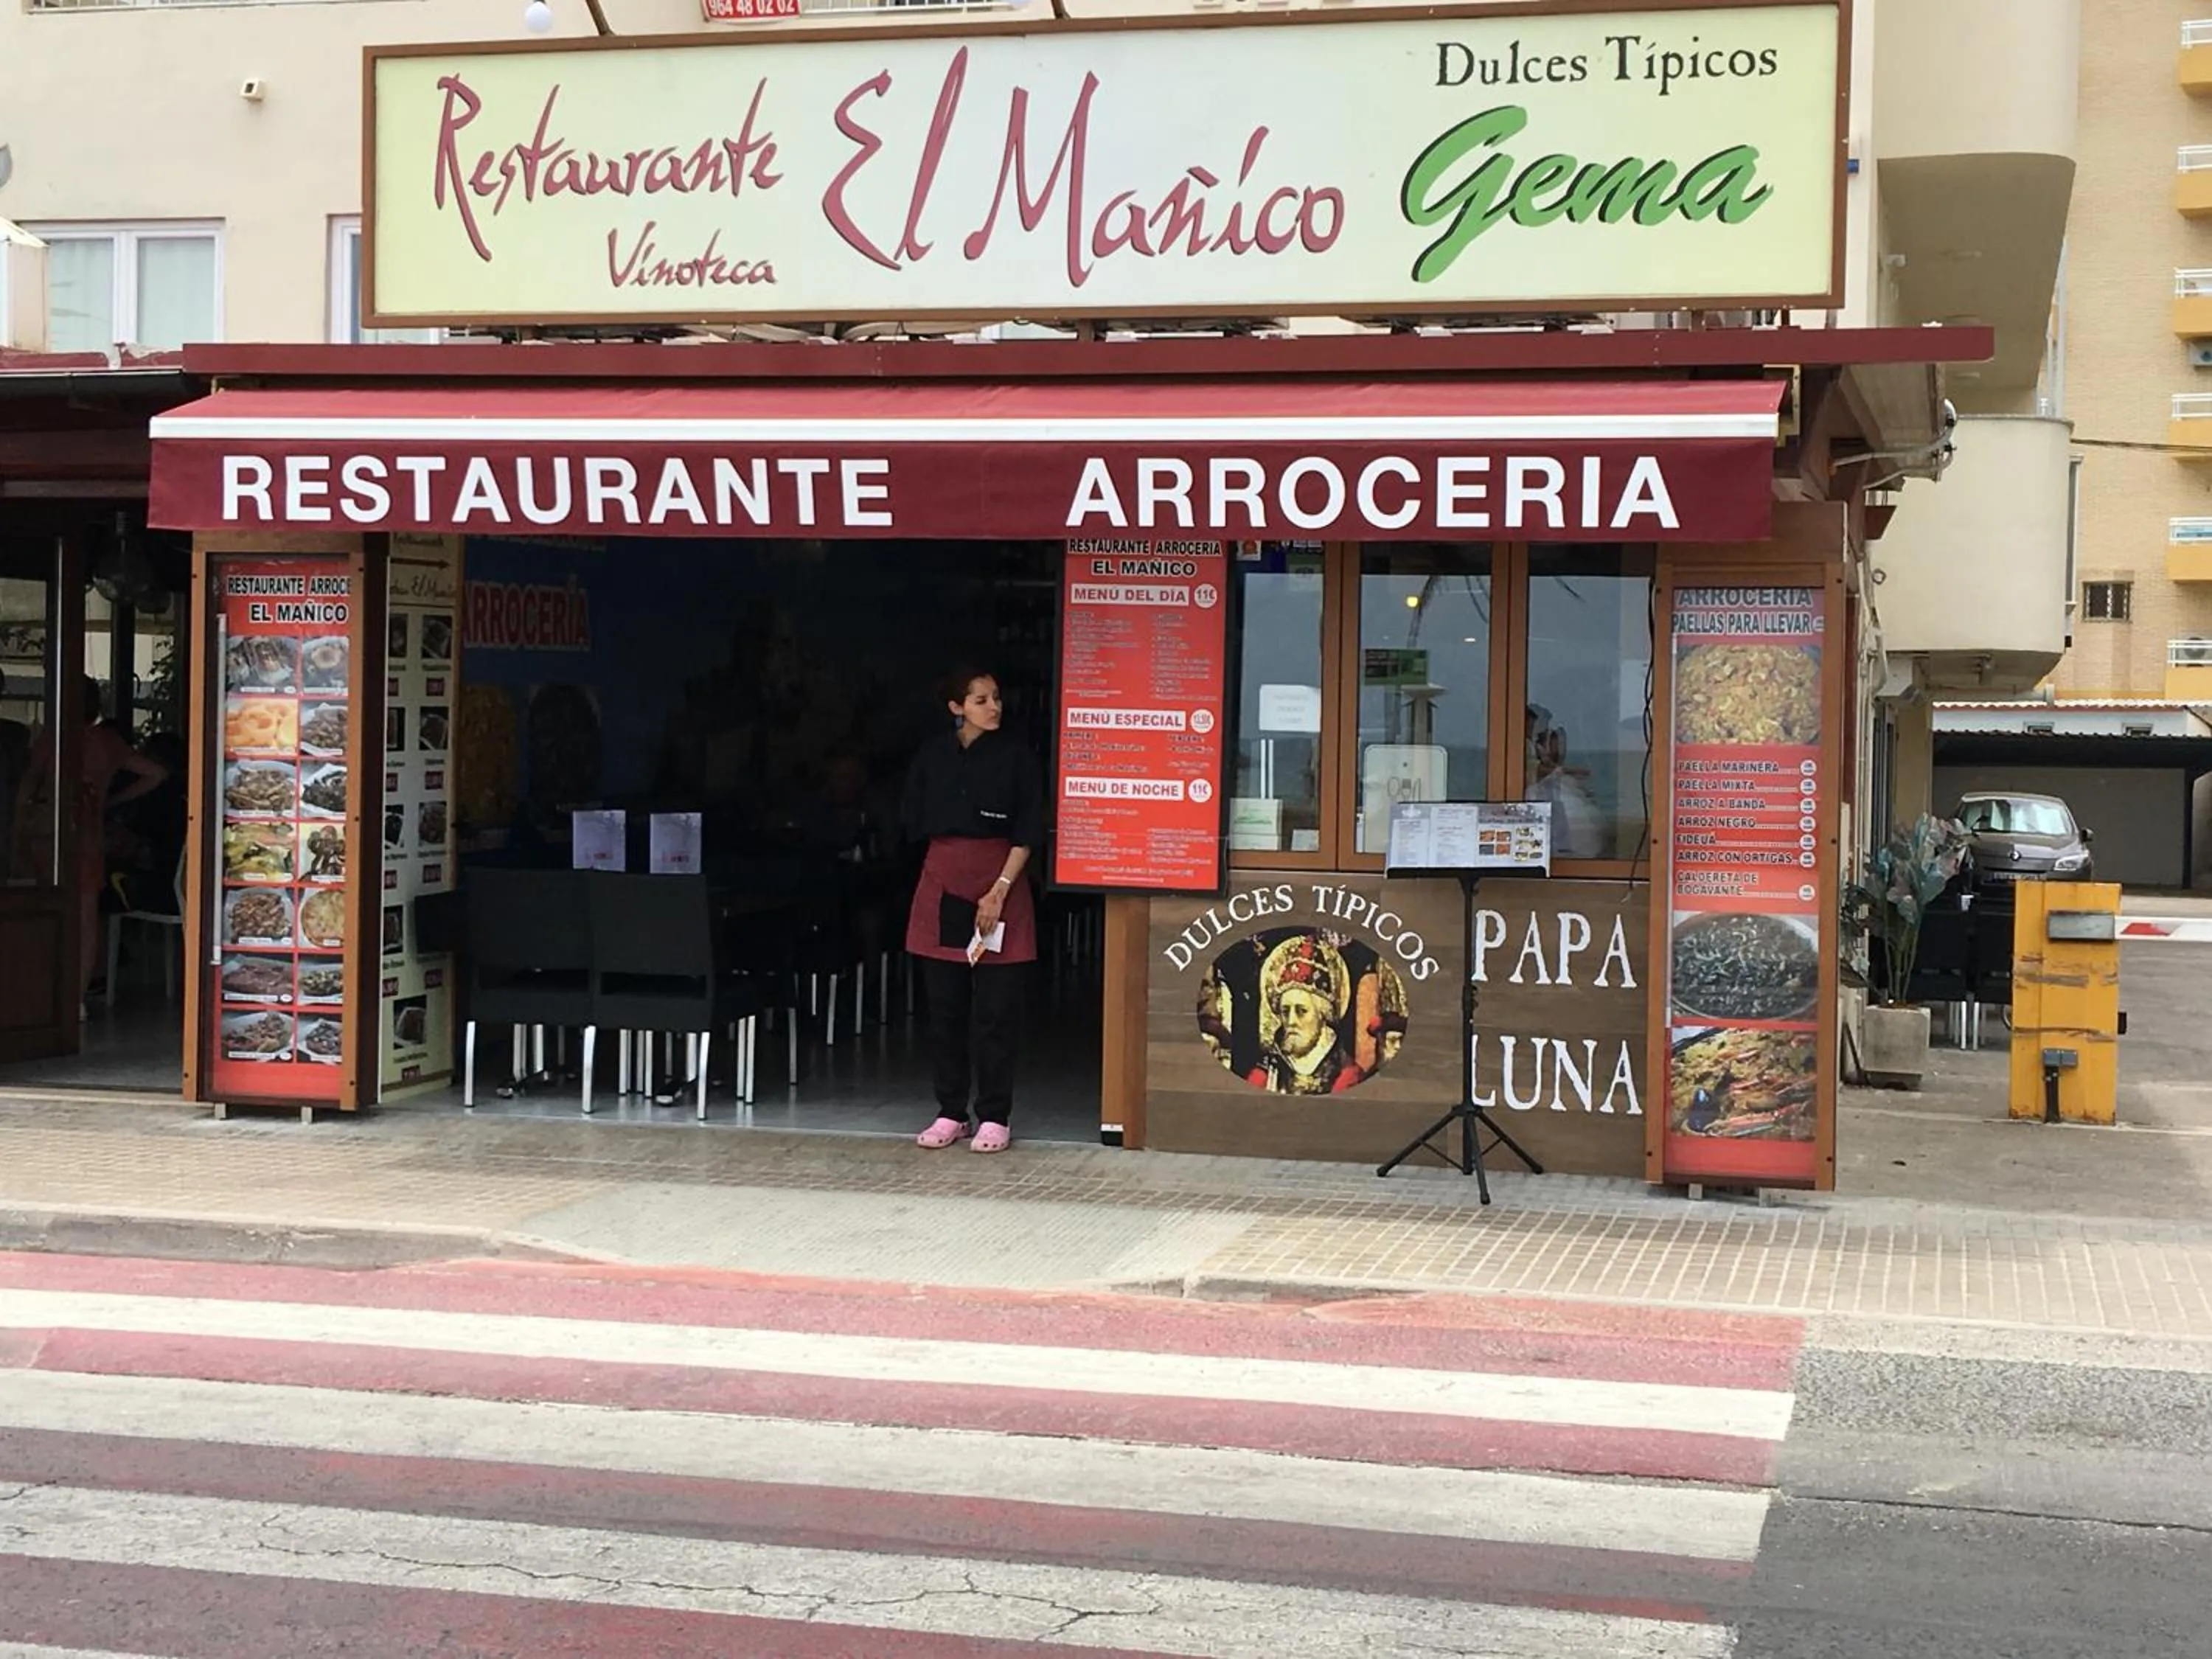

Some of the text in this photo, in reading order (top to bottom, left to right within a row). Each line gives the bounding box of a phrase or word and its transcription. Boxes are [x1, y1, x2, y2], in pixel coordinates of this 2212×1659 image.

[1435, 34, 1778, 102] Dulces Típicos
[434, 73, 784, 262] Restaurante
[822, 45, 969, 271] El
[1399, 105, 1775, 285] Gema
[222, 454, 893, 526] RESTAURANTE
[1065, 456, 1680, 530] ARROCERIA
[1068, 539, 1222, 555] RESTAURANTE ARROCERIA
[1093, 557, 1195, 575] EL MAÑICO
[227, 577, 305, 595] RESTAURANTE
[1124, 589, 1154, 602] DEL
[250, 600, 347, 622] EL MAÑICO
[1672, 613, 1724, 633] PAELLAS
[1728, 613, 1760, 633] PARA
[1764, 613, 1810, 633] LLEVAR
[1115, 713, 1183, 727] ESPECIAL
[1677, 761, 1779, 772] PAELLA MARINERA
[1111, 782, 1127, 794] DE
[1132, 783, 1179, 796] NOCHE
[1678, 780, 1756, 790] PAELLA MIXTA
[1677, 799, 1766, 810] ARROZ A BANDA
[1677, 817, 1756, 828] ARROZ NEGRO
[1677, 852, 1715, 862] ARROZ
[1717, 852, 1741, 862] CON
[1744, 852, 1793, 863] ORTIGAS
[1744, 872, 1758, 883] DE
[1162, 884, 1441, 982] DULCES TÍPICOS
[1470, 908, 1638, 989] PAPA
[1470, 1034, 1644, 1115] LUNA
